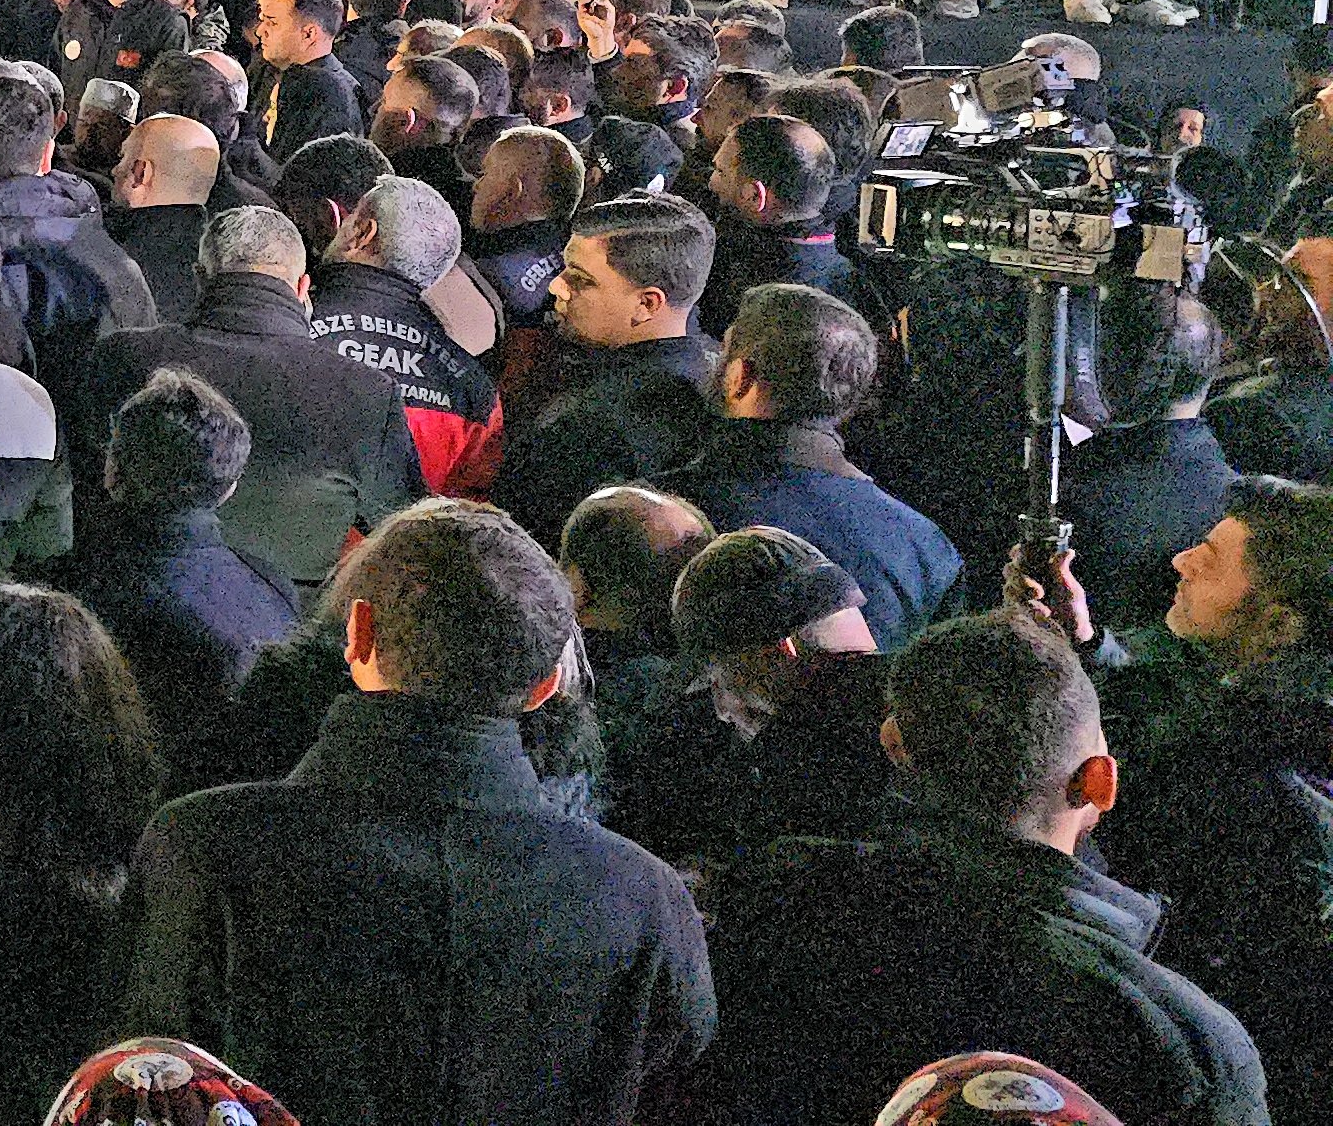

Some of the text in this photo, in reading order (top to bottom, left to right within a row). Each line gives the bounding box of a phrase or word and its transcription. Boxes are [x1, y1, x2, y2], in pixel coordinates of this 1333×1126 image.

[308, 314, 356, 341] EBZE
[337, 338, 425, 378] GEAK
[400, 383, 453, 410] TARMA
